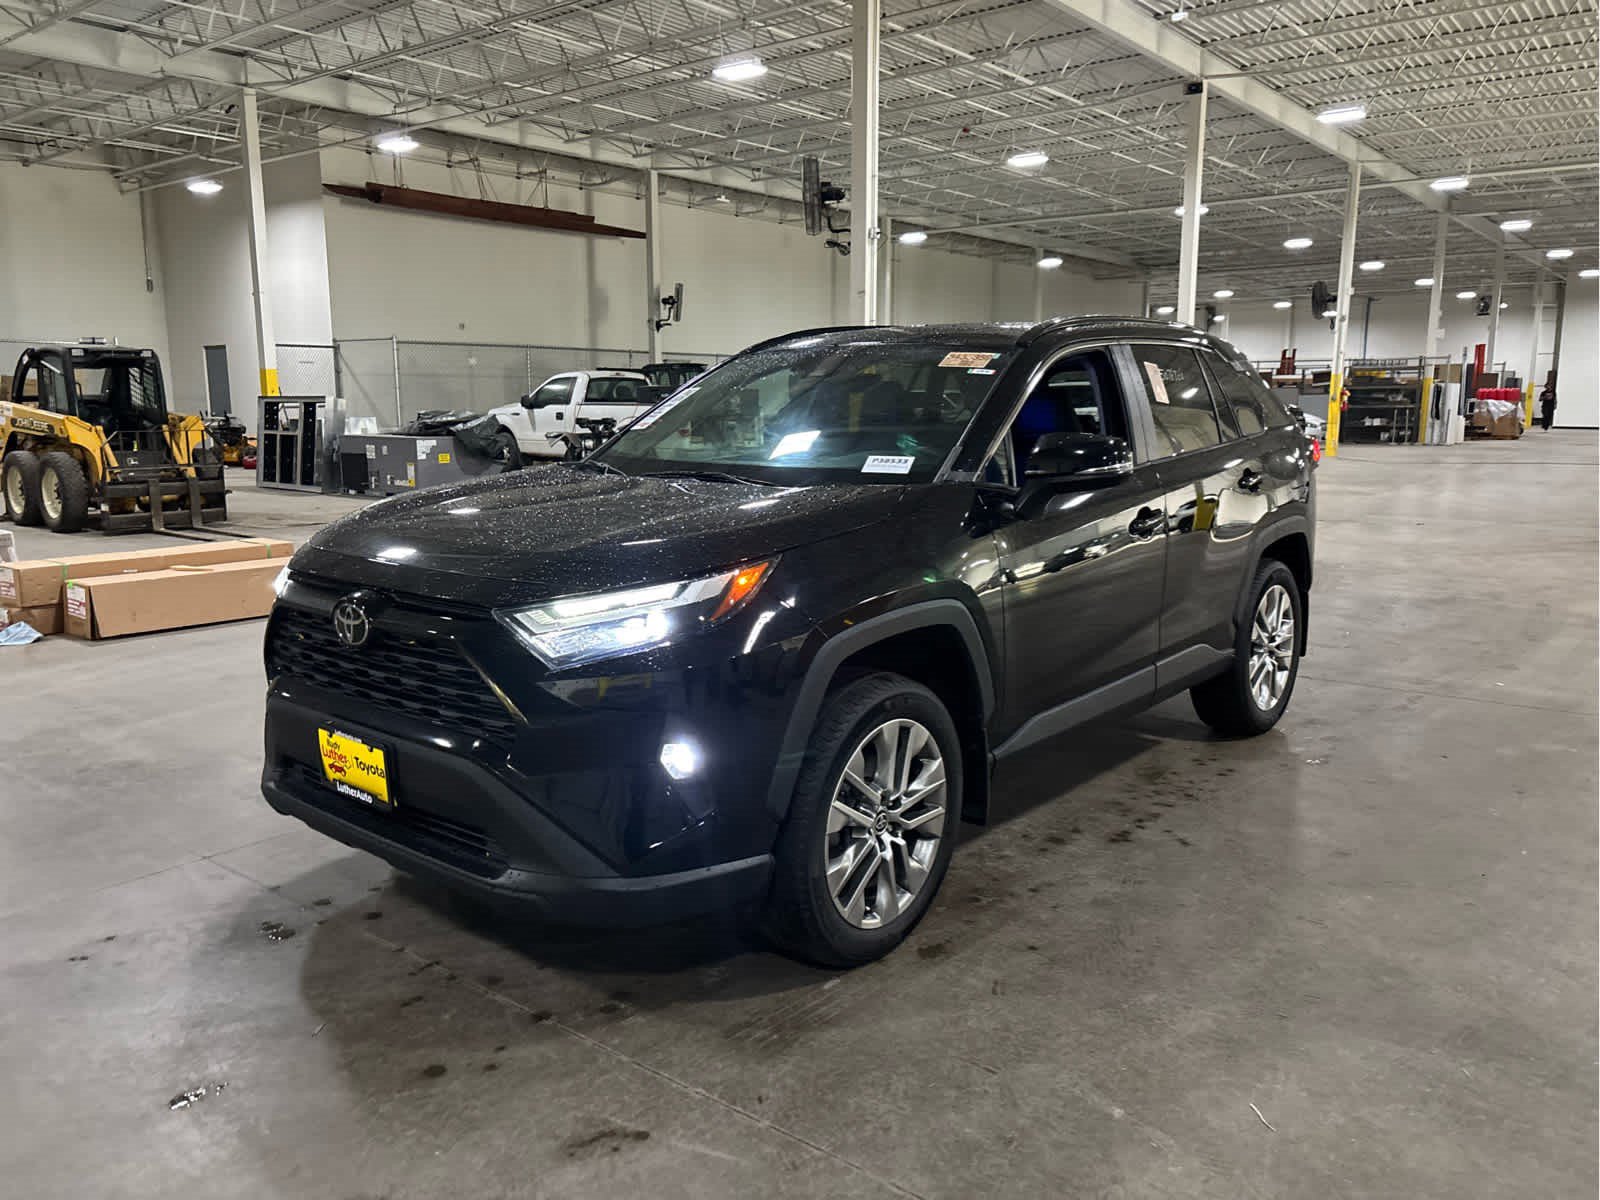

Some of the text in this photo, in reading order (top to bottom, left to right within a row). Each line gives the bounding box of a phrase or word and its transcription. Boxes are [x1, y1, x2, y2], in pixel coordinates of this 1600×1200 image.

[30, 418, 50, 432] DEERE
[321, 744, 348, 764] Luther
[354, 756, 385, 778] Toyota
[336, 780, 373, 804] LutherAuto
